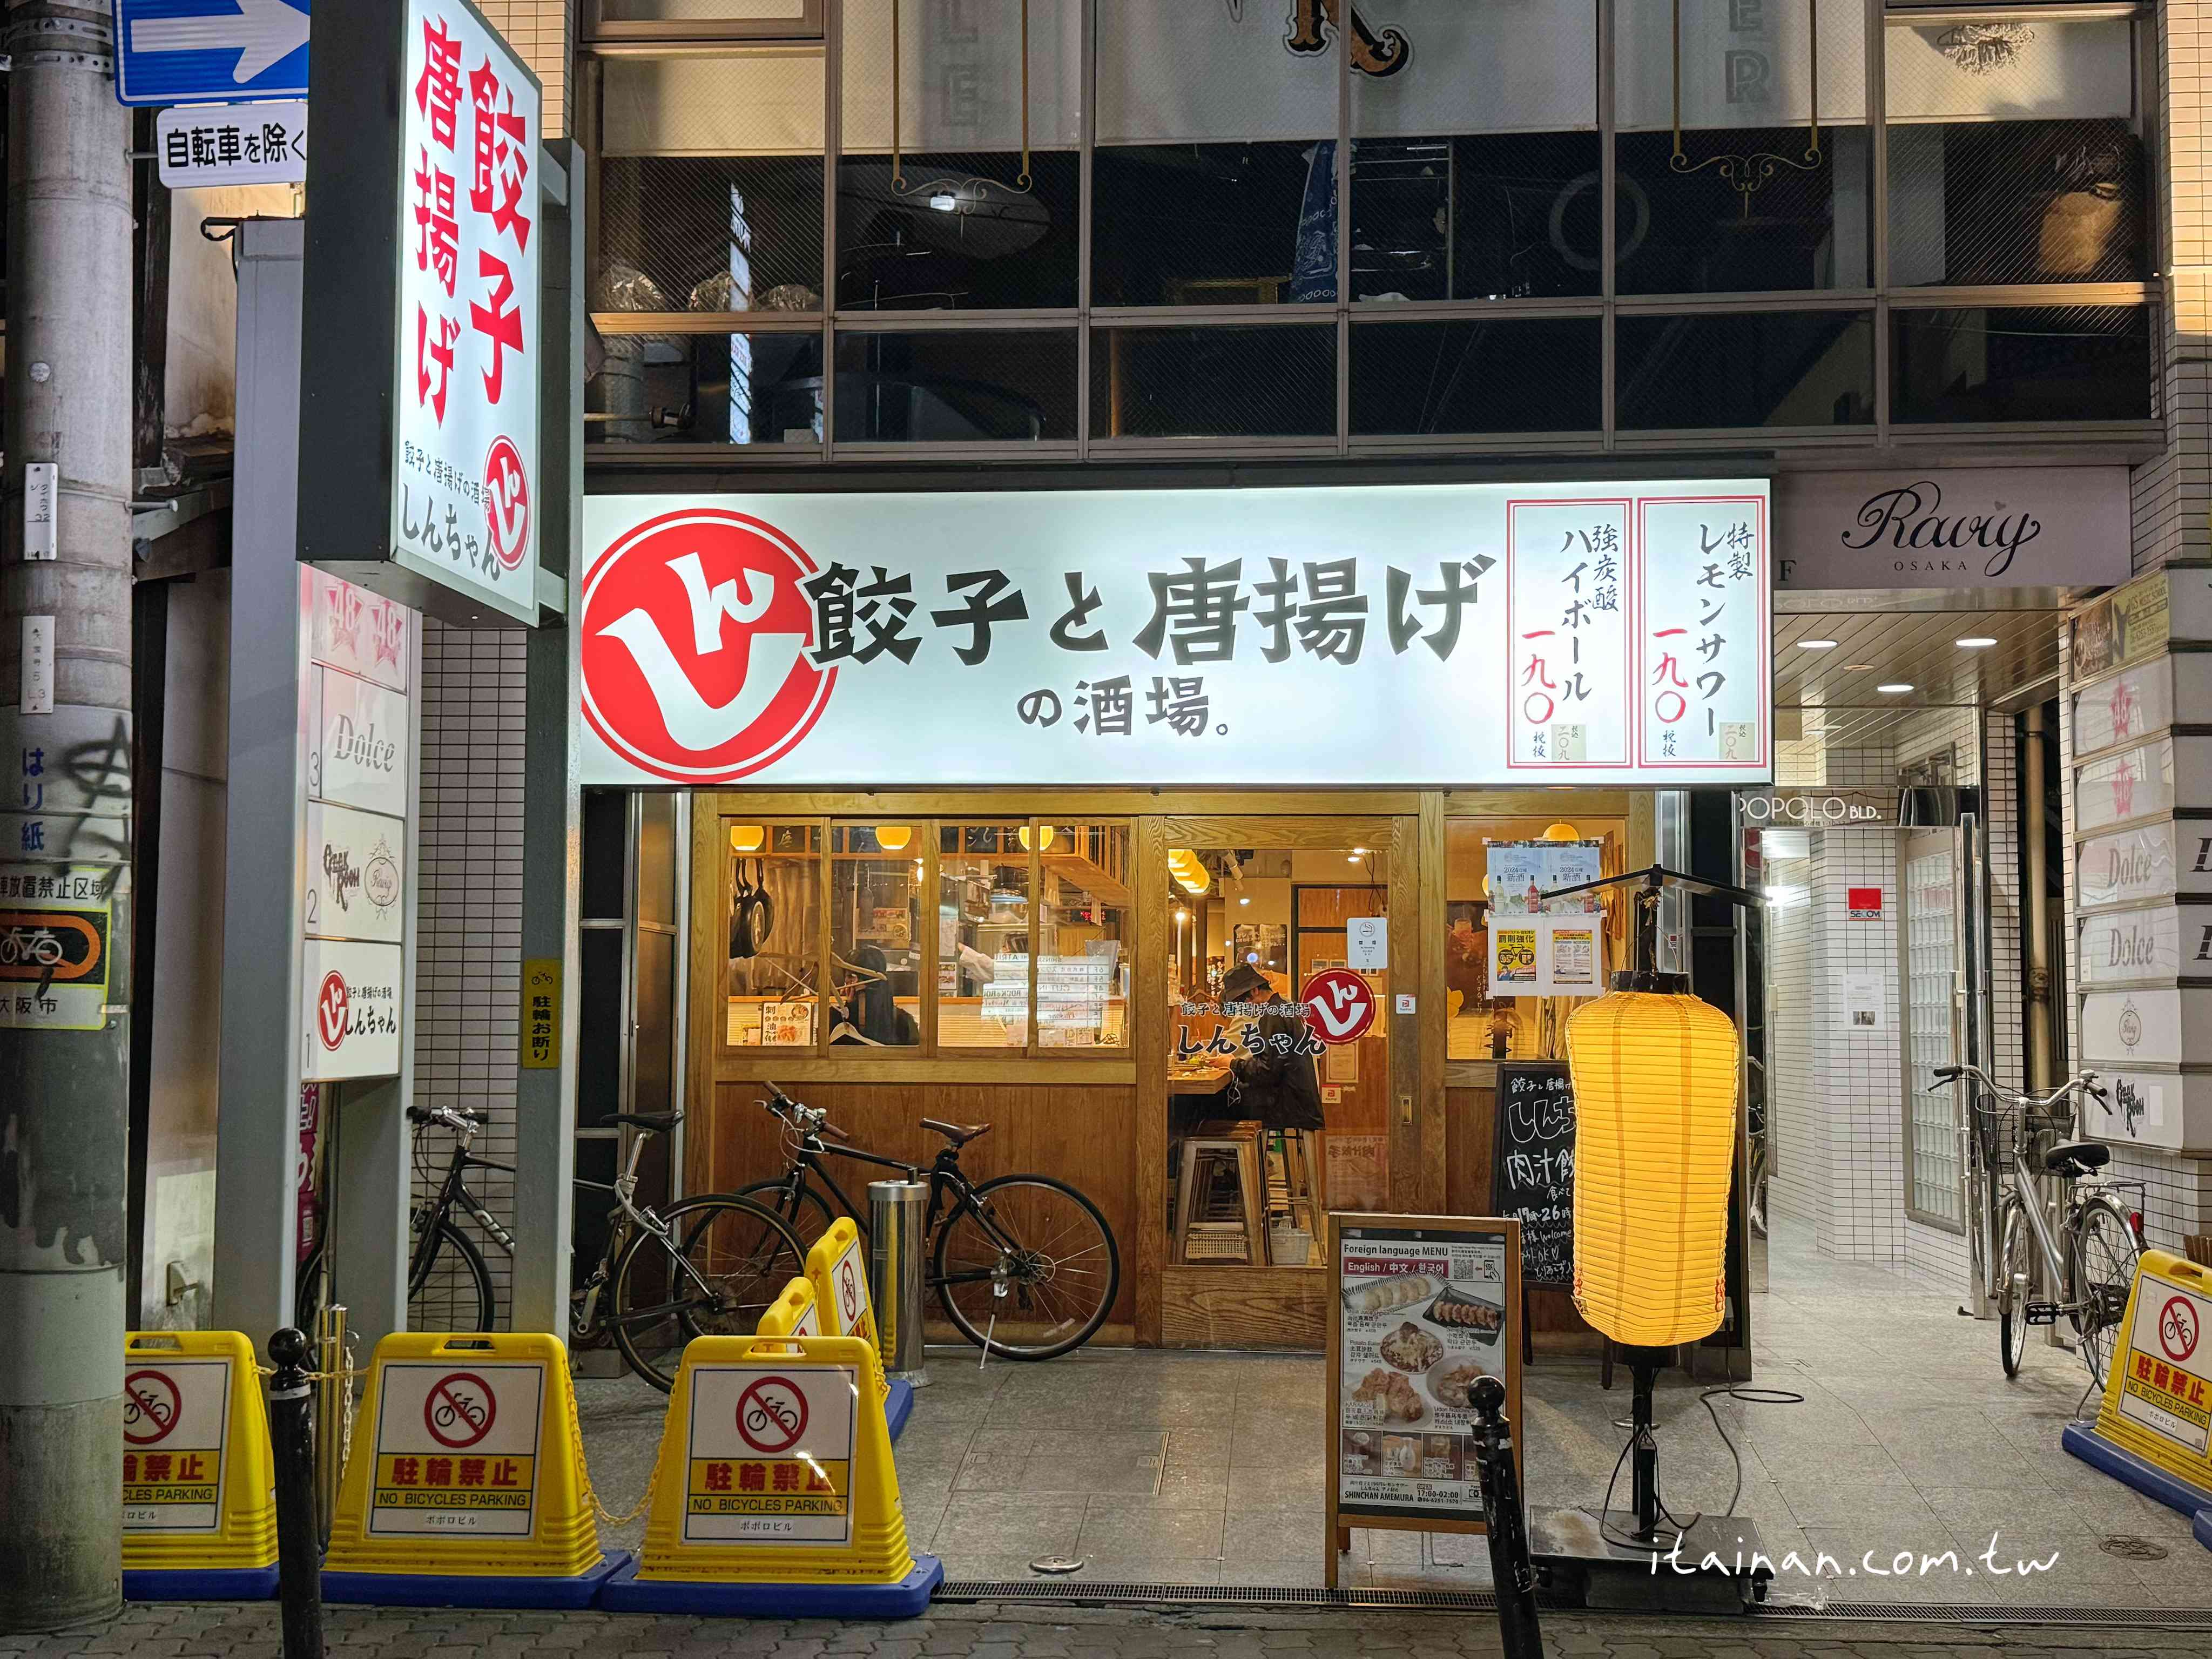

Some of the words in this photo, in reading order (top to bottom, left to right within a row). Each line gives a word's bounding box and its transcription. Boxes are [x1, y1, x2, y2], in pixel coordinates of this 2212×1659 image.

[166, 122, 306, 168] 自転車を除く
[414, 14, 463, 428] 唐揚げ
[468, 53, 530, 405] 餃子
[404, 440, 491, 512] 餃子と唐揚げの酒場
[402, 482, 501, 582] しんちゃん
[1591, 523, 1619, 612] 強炭酸
[1727, 521, 1755, 581] 特製
[1894, 561, 1967, 571] OSAKA
[804, 553, 1496, 666] 餃子と唐揚げ
[1560, 530, 1593, 702] ハイボール
[1695, 523, 1727, 737] レモンサワー
[334, 713, 395, 773] Dolce
[309, 751, 320, 787] 3
[22, 747, 45, 852] はり紙
[1850, 805, 1882, 820] BLD.
[2107, 843, 2152, 887] Dolce
[307, 888, 317, 924] 2
[2108, 926, 2154, 967] Dolce
[344, 1006, 396, 1036] しんちゃん
[1180, 1001, 1311, 1018] 餃子と唐揚げの酒場
[1177, 1022, 1328, 1055] しんちゃん
[1344, 1244, 1377, 1255] Foreign
[1379, 1245, 1420, 1257] language
[1422, 1246, 1448, 1256] MENU
[1348, 1262, 1380, 1274] English
[1389, 1262, 1410, 1273] 中文
[1418, 1263, 1444, 1274] 한국어
[2136, 1355, 2205, 1406] 駐輪禁止
[2128, 1381, 2139, 1393] NO
[2141, 1386, 2174, 1410] BICYCLES
[2174, 1404, 2207, 1425] PARKING
[391, 1458, 518, 1486] 駐輪禁止
[704, 1462, 832, 1492] 駐輪禁止
[155, 1488, 213, 1500] PARKING
[379, 1493, 398, 1504] NO
[404, 1493, 467, 1505] BICYCLES
[469, 1494, 527, 1506] PARKING
[693, 1499, 712, 1510] NO
[719, 1499, 781, 1511] BICYCLES
[785, 1500, 842, 1512] PARKING
[1345, 1491, 1378, 1500] SHINCHAN
[1380, 1493, 1414, 1502] AMEMURA
[1417, 1489, 1459, 1499] 17:00-02:00
[122, 1511, 156, 1520] ロビル
